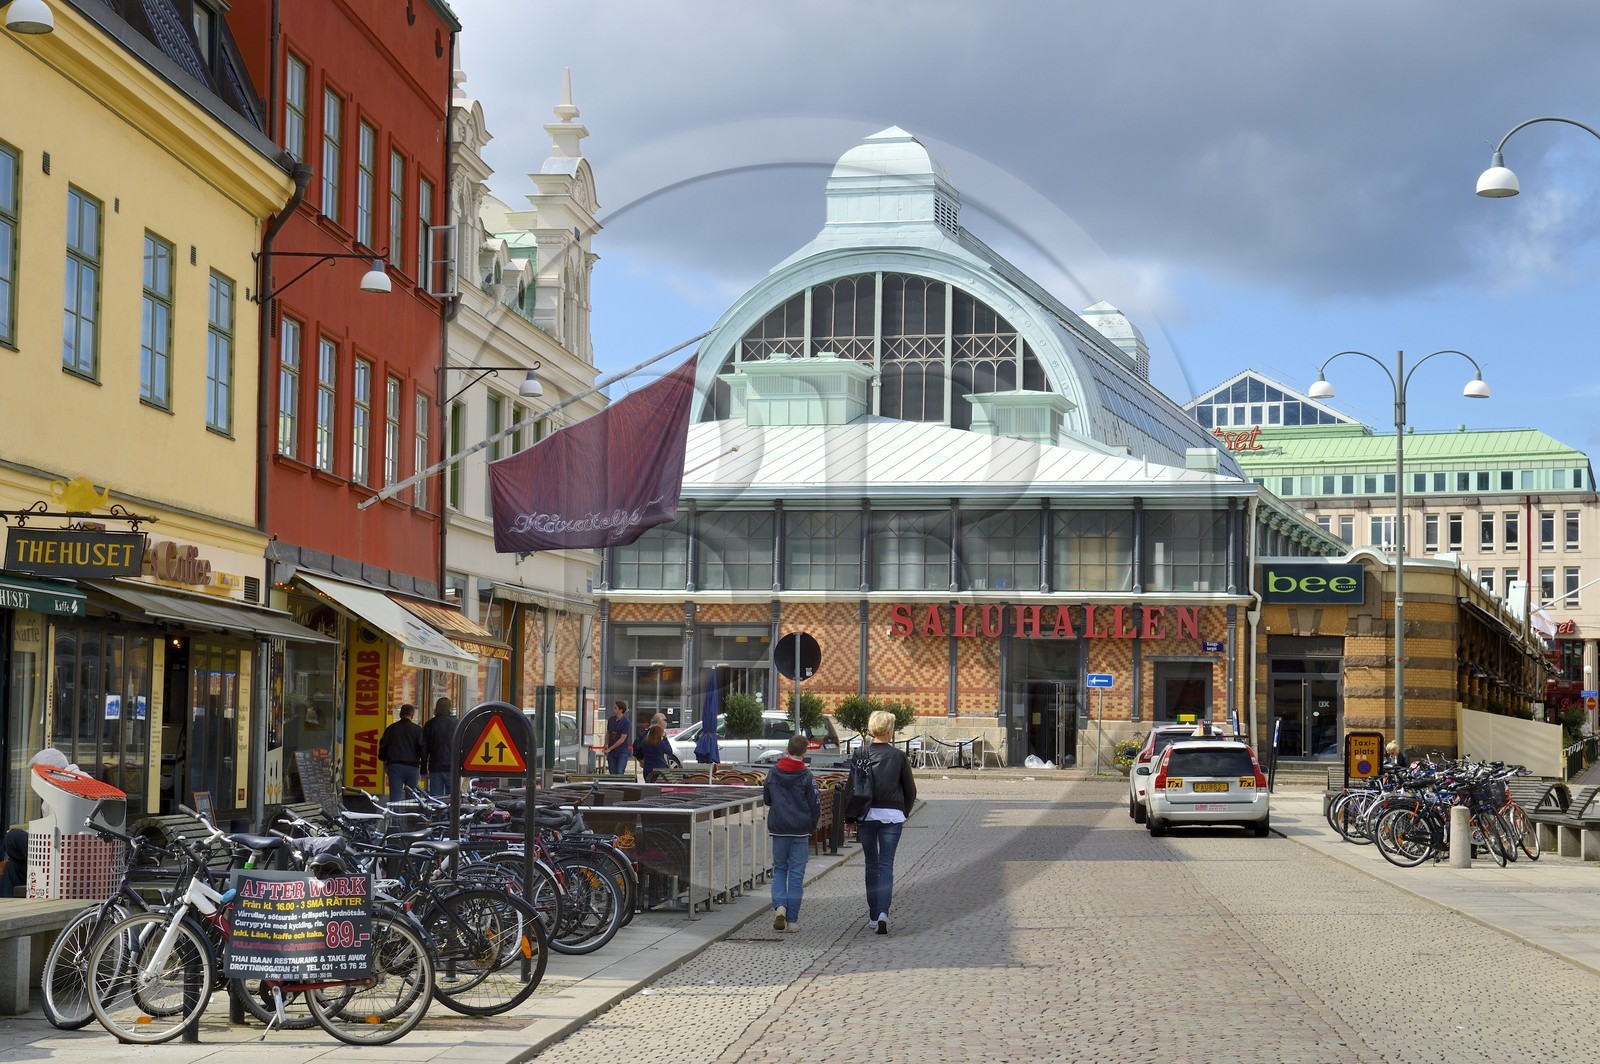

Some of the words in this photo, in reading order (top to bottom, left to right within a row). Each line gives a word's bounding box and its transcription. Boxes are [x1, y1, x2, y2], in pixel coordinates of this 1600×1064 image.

[16, 539, 135, 568] THEHUSET
[158, 540, 212, 586] Coffee
[1268, 571, 1357, 593] bee
[54, 600, 70, 612] Kaffe
[891, 603, 1202, 640] SALUHALLEN
[355, 650, 380, 716] KEBAB
[354, 729, 379, 788] PIZZA
[240, 879, 305, 901] AFTER
[308, 876, 366, 897] WORK
[243, 899, 260, 908] Från
[264, 902, 272, 910] kl.
[276, 902, 294, 911] 16.00
[307, 898, 324, 908] SMÅ
[326, 897, 362, 906] RÄTTER
[235, 920, 271, 930] Currygryta
[230, 964, 290, 972] DROTTNINGGATAN
[274, 956, 318, 964] RESTAURANG
